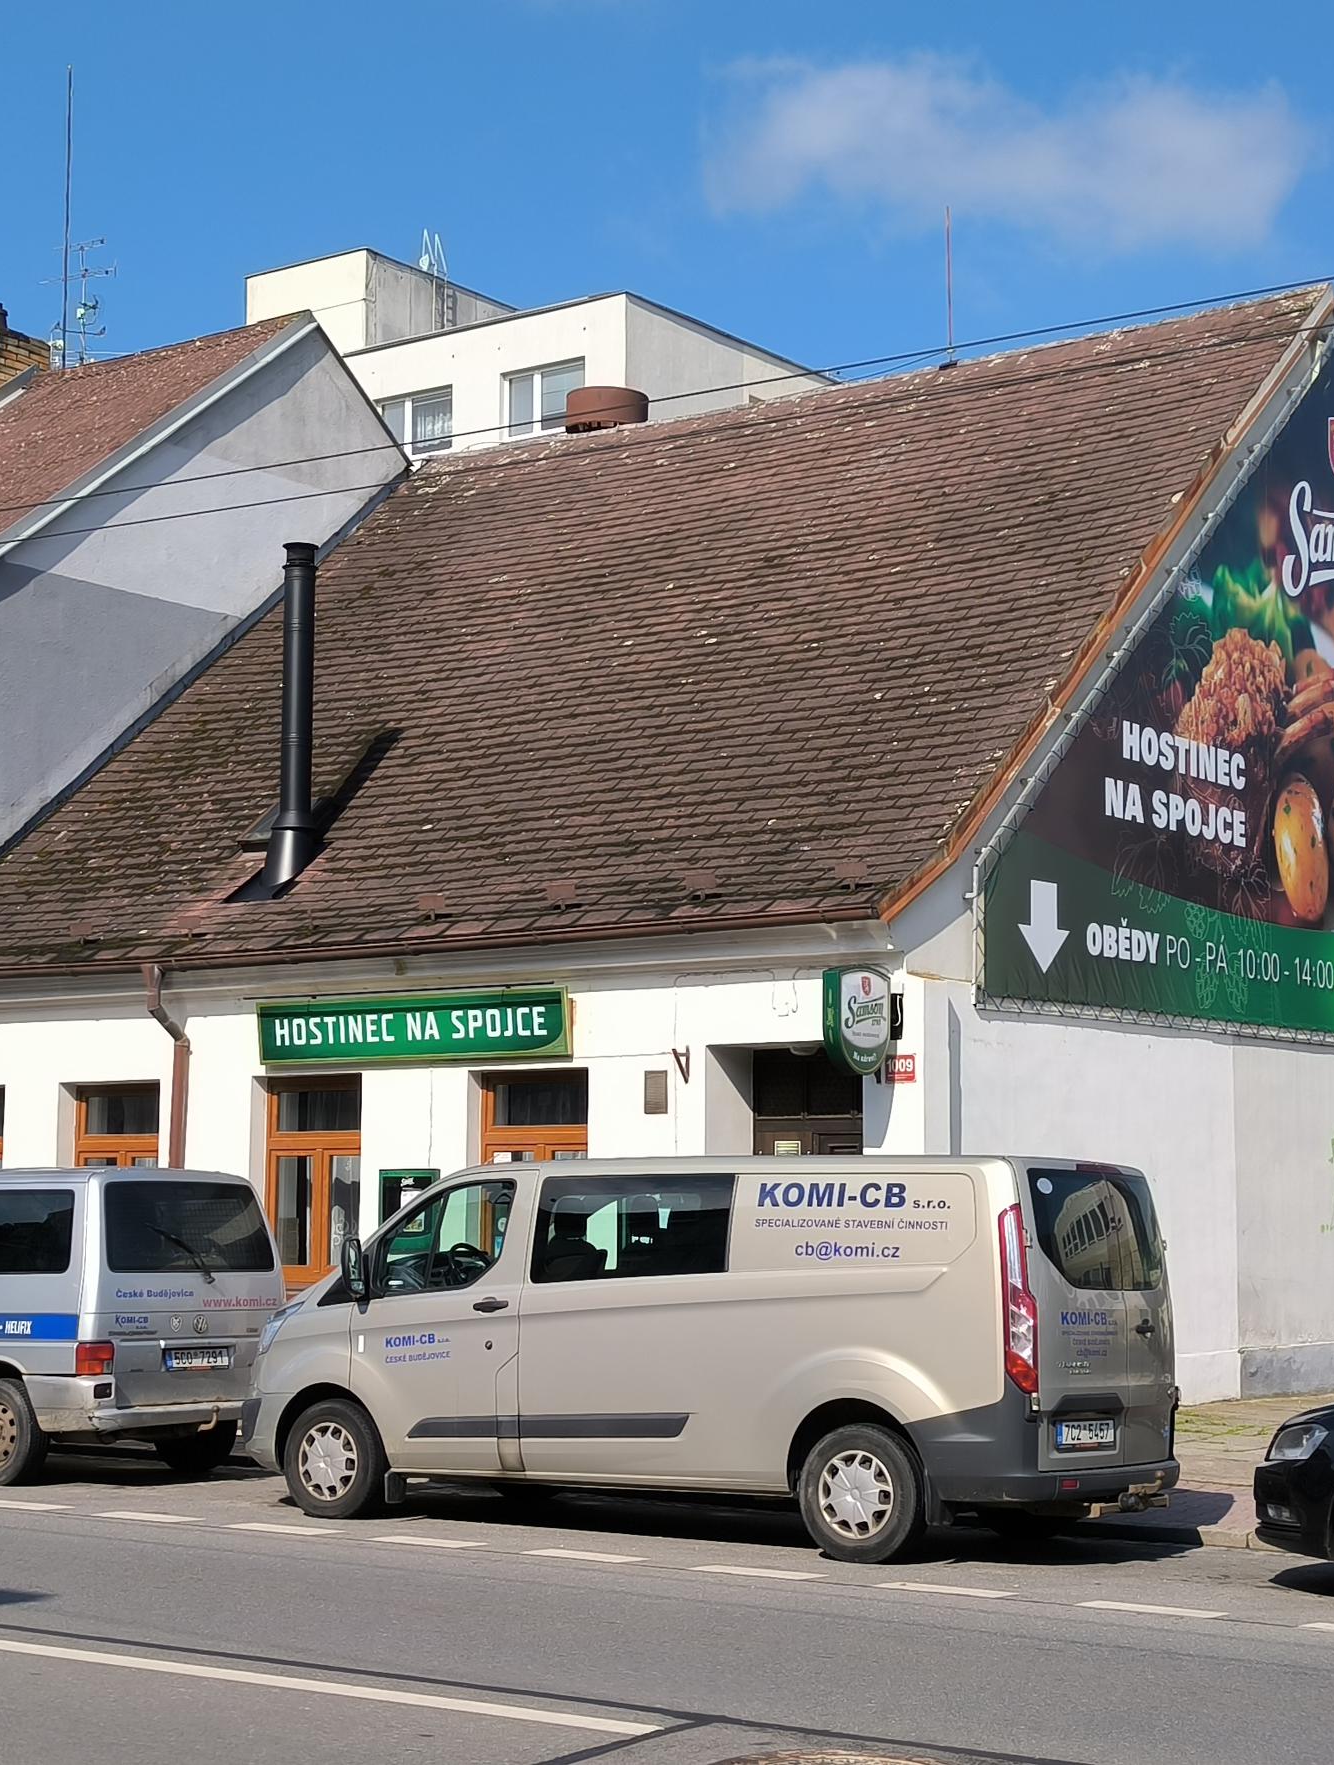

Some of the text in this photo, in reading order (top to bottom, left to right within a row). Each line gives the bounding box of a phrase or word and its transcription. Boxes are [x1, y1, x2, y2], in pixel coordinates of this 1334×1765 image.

[1122, 720, 1247, 790] HOSTINEC
[1105, 777, 1247, 848] NA SPOJCE
[1086, 918, 1160, 964] OBĚDY
[1166, 935, 1191, 969] PO
[1206, 935, 1229, 976] PÁ
[1238, 948, 1280, 983] 10:00
[1294, 957, 1334, 990] 14:00
[844, 995, 887, 1029] Samson
[275, 1006, 548, 1046] HOSTINEC NA SPOJCE
[886, 1058, 914, 1072] 1009
[757, 1182, 951, 1210] KOMI-CB s.r.o.
[754, 1216, 948, 1231] SPECIALIZOVANÉ STAVEBNÍ ČINNOSTI
[795, 1241, 900, 1261] cb@komi.cz
[115, 1288, 145, 1299] České
[202, 1296, 278, 1308] www.komi.cz
[1061, 1311, 1107, 1326] KOMI-CB
[385, 1333, 436, 1348] KOMI-CB
[174, 1350, 224, 1365] 5C0 7291
[1064, 1422, 1110, 1441] 7C2 5457
